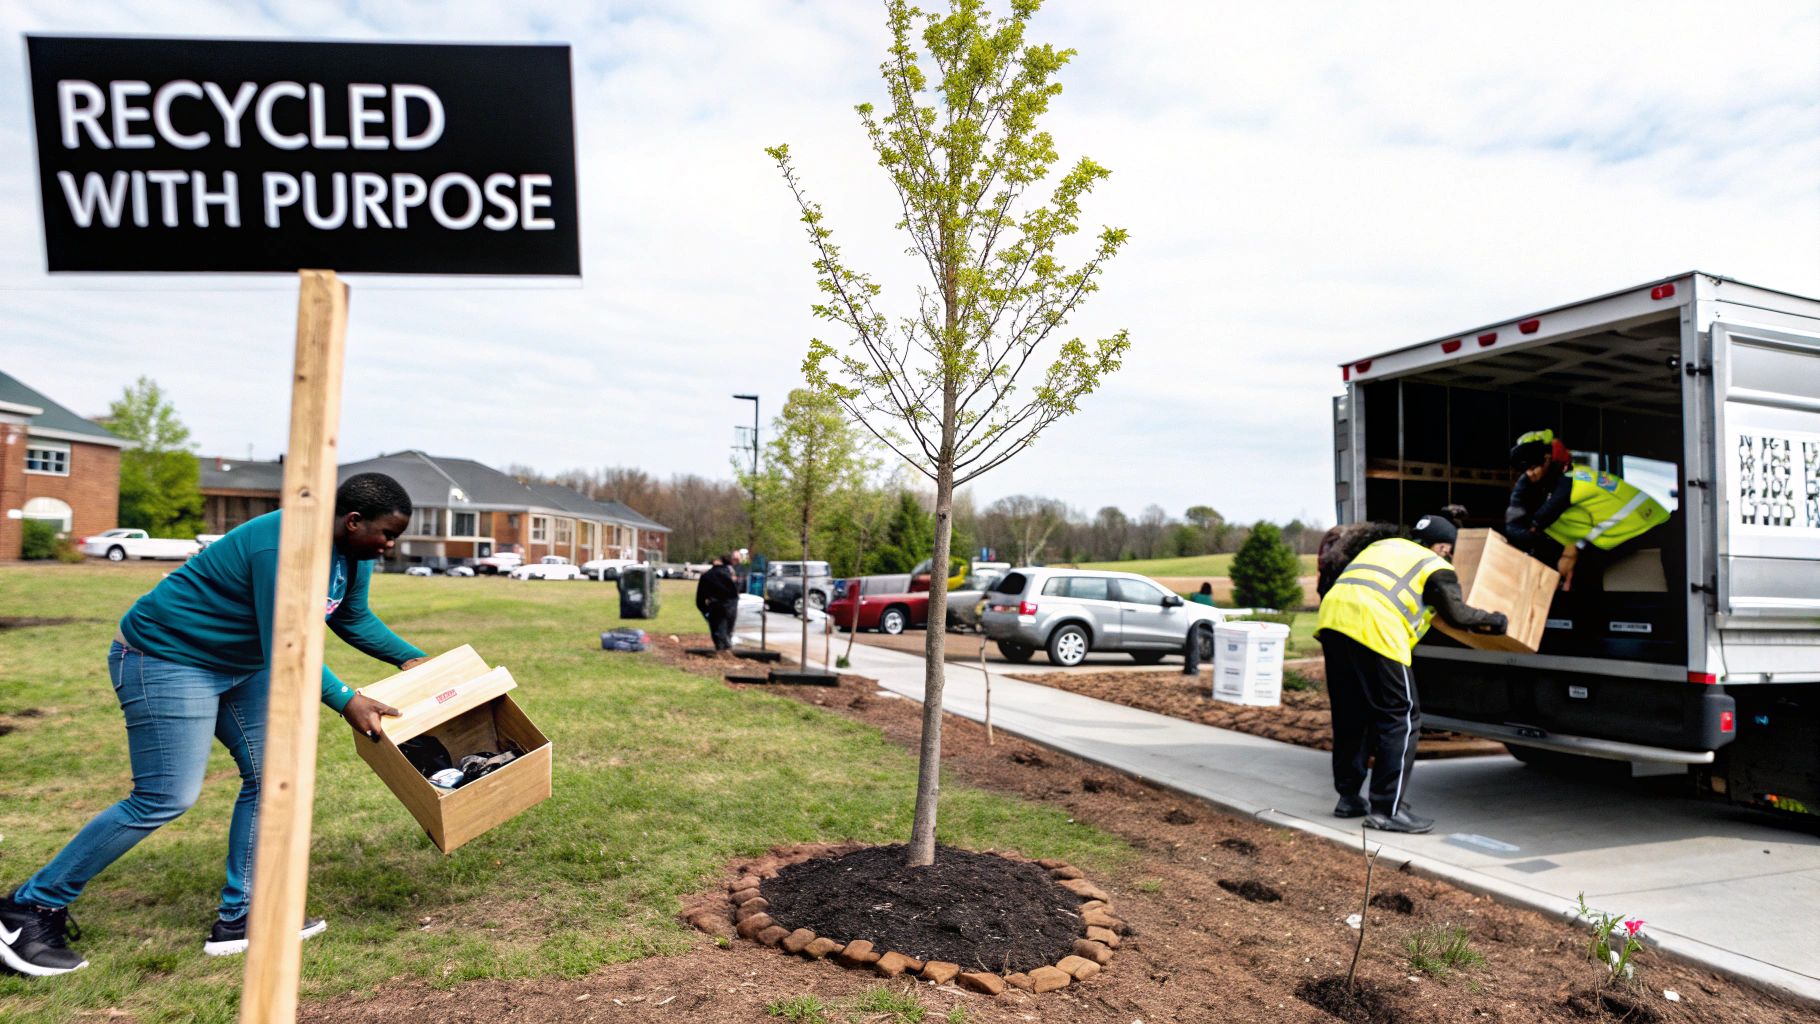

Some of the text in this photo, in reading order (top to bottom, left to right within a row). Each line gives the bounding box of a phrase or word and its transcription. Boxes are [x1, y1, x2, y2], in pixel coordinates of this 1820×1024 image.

[57, 79, 446, 150] RECYCLED
[57, 170, 556, 231] WITH PURPOSE
